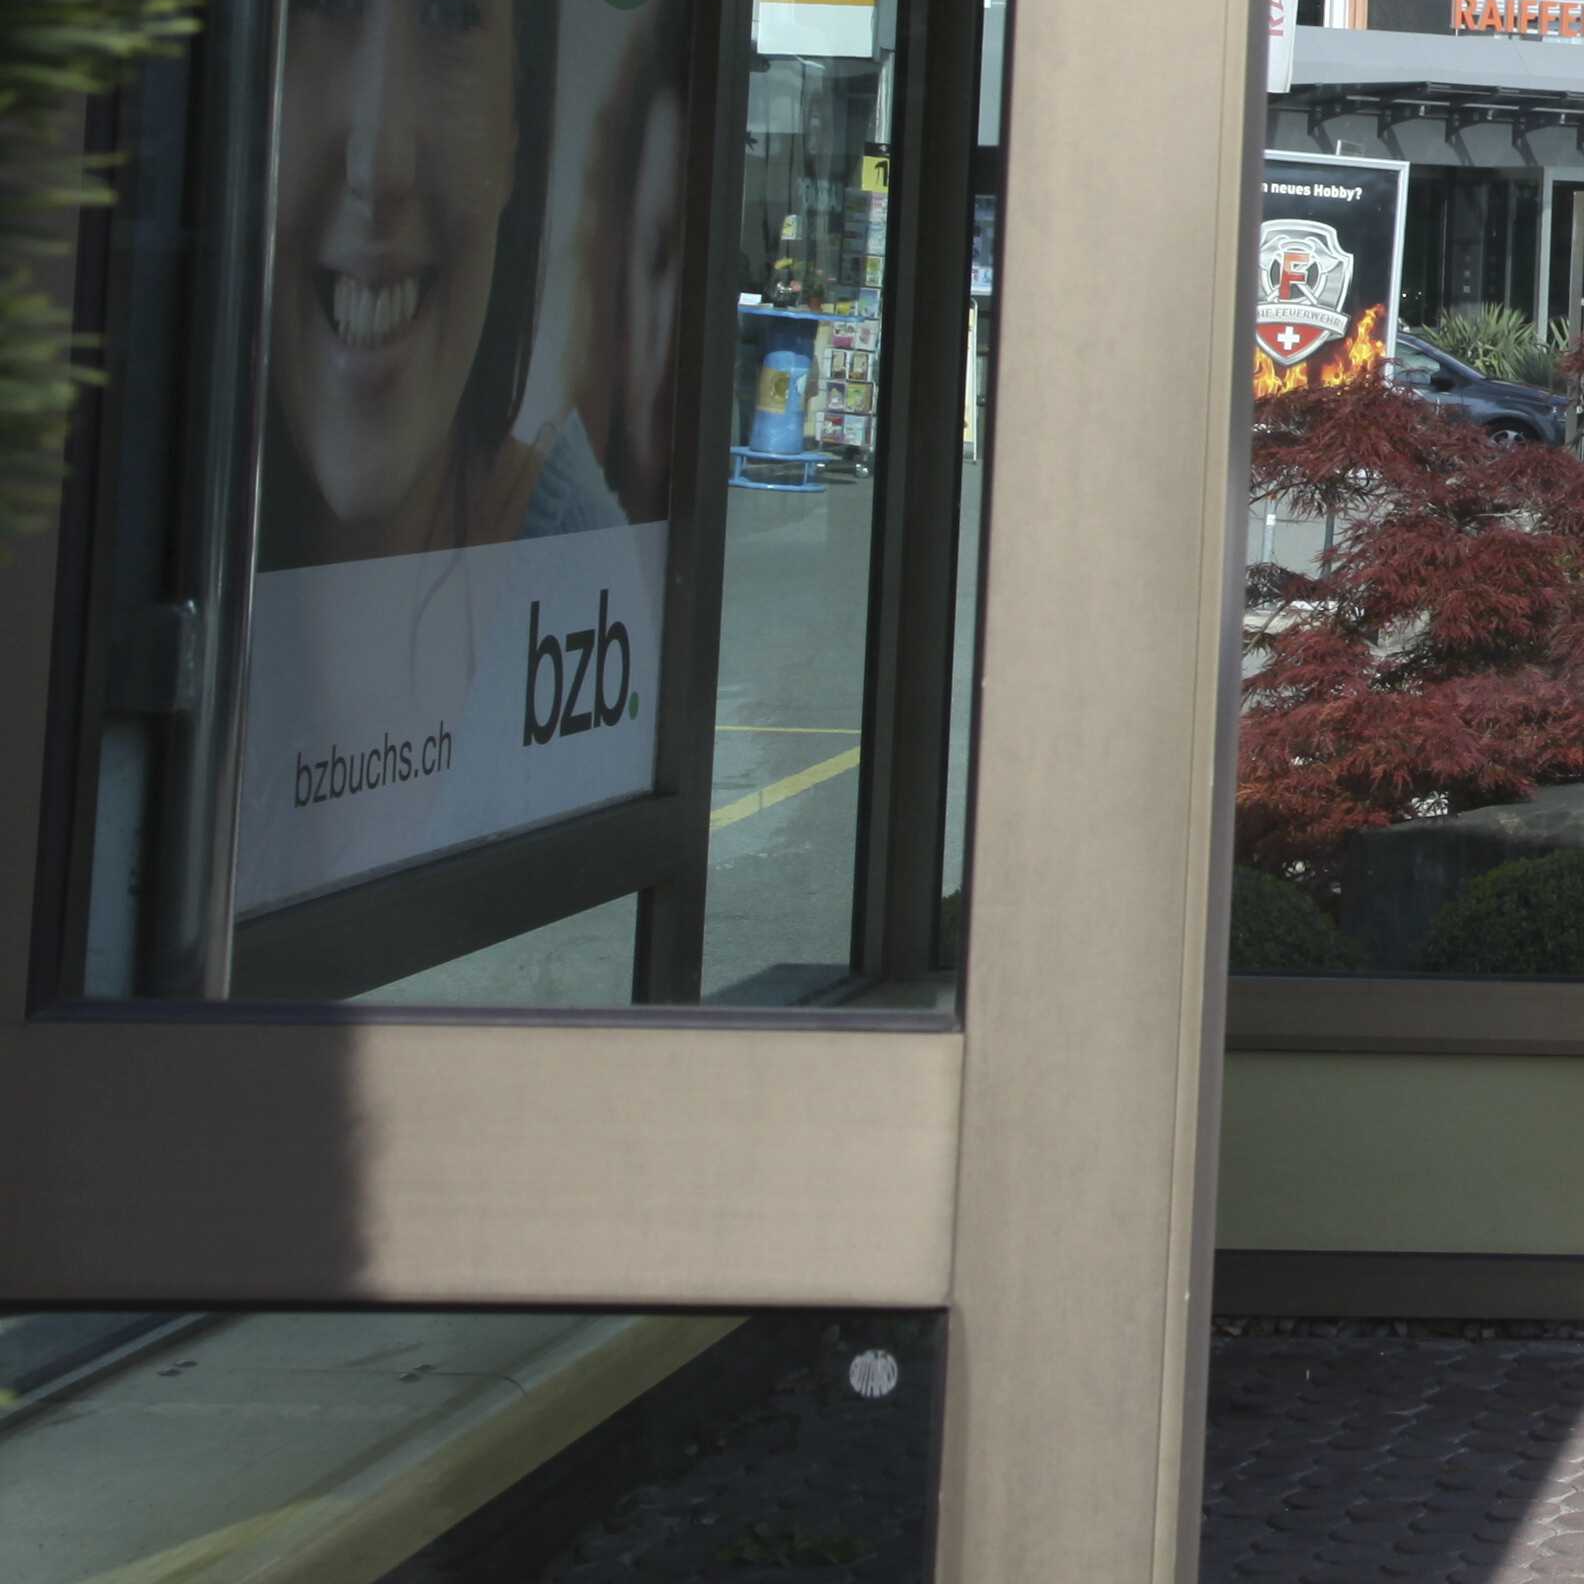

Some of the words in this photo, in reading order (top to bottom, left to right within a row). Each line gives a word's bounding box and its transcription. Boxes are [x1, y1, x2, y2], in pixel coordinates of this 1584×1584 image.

[1270, 182, 1312, 197] neues
[1313, 184, 1363, 202] Hobby?
[522, 588, 640, 747] bzb.
[292, 721, 453, 810] bzbuchs.ch
